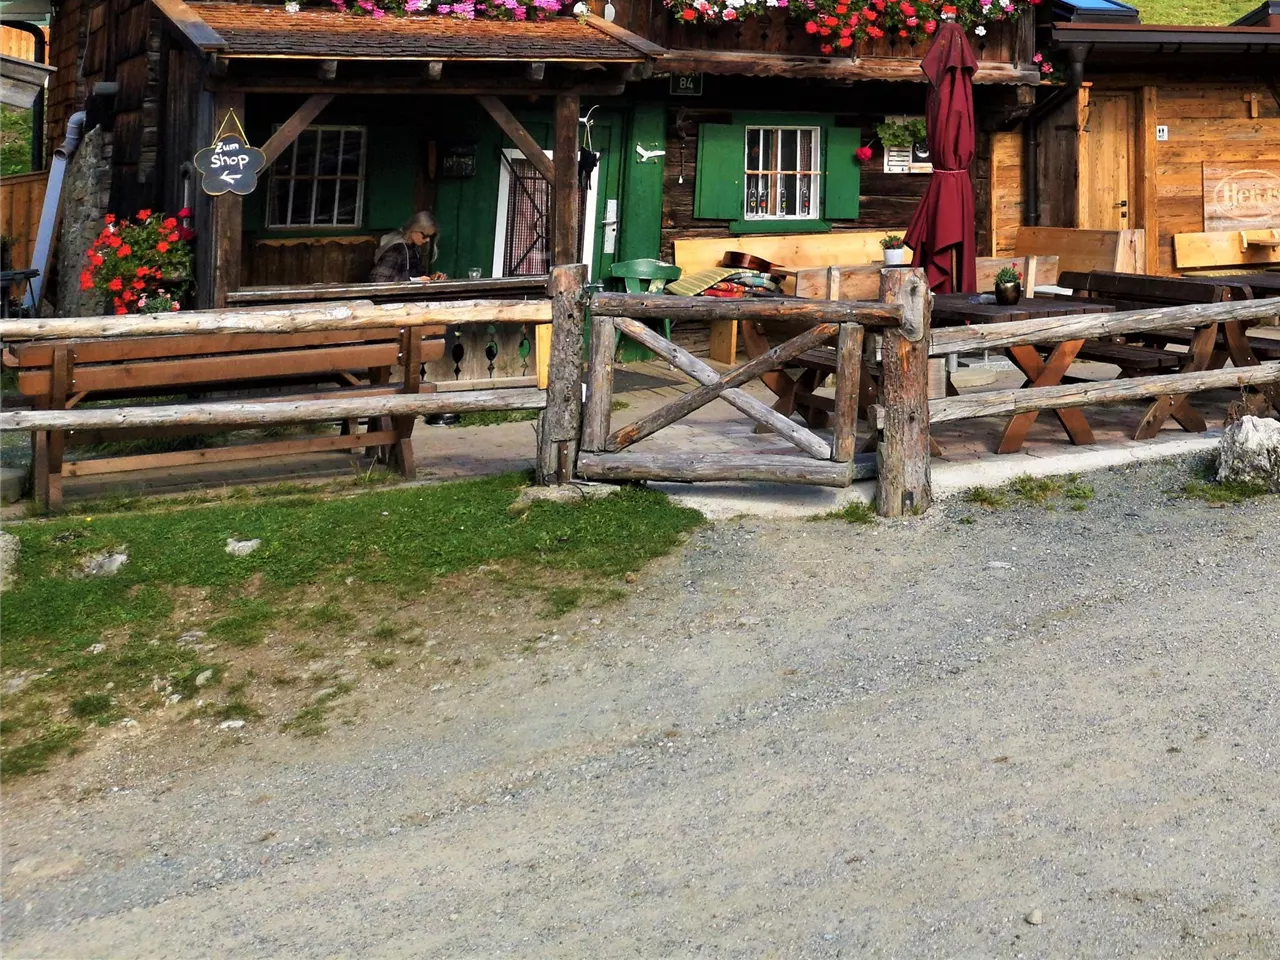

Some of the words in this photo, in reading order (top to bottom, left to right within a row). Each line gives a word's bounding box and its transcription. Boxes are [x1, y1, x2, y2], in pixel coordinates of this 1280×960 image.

[680, 77, 693, 89] 84
[214, 141, 239, 153] Zum
[210, 153, 249, 170] Shop
